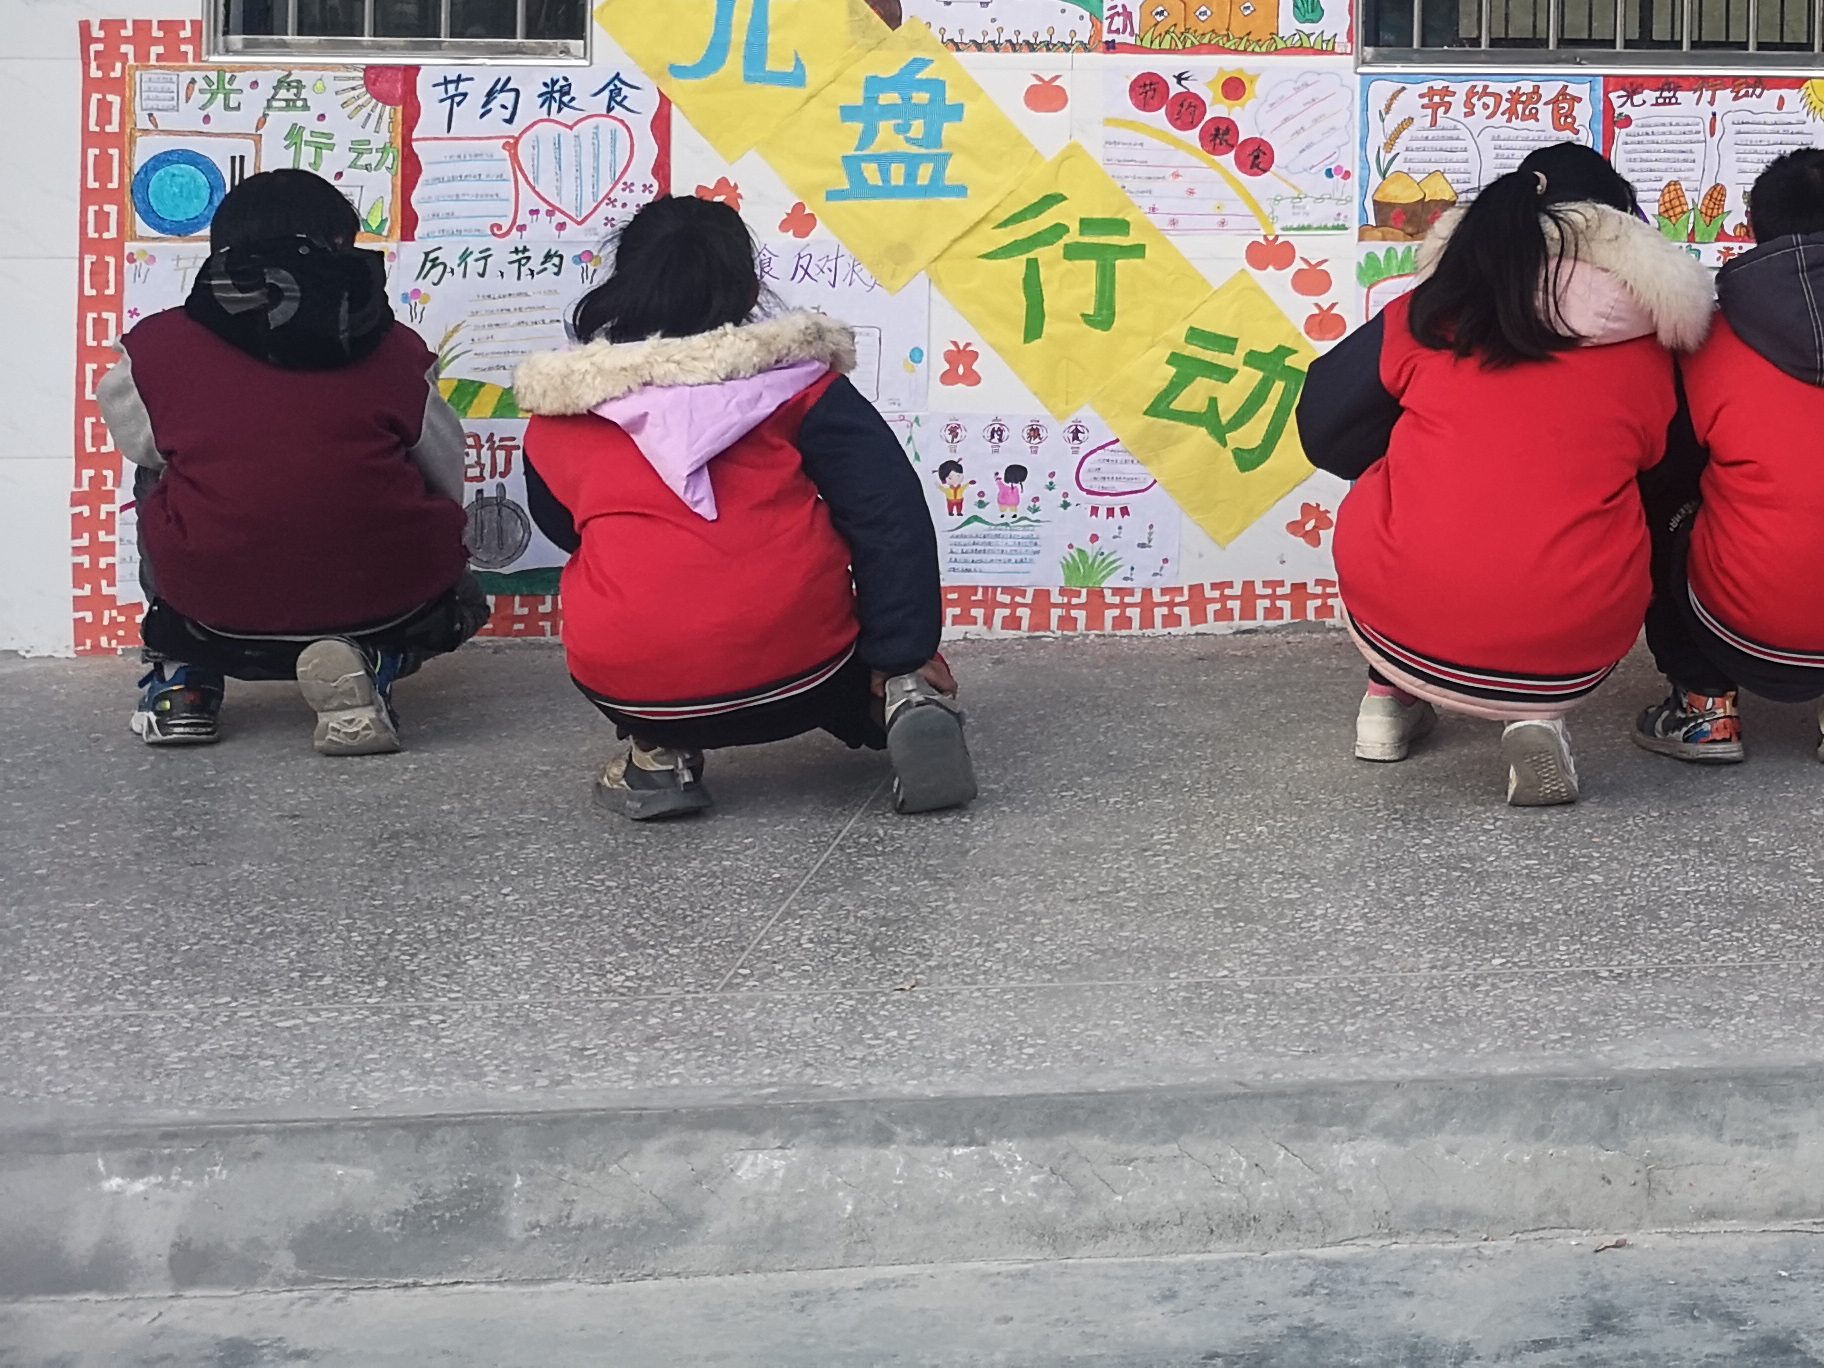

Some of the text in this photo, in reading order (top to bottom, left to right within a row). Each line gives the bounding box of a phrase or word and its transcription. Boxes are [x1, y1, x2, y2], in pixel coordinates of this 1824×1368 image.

[432, 71, 643, 134] 节约粮食
[1417, 85, 1584, 135] 节约粮食
[414, 245, 564, 286] 厉行节约
